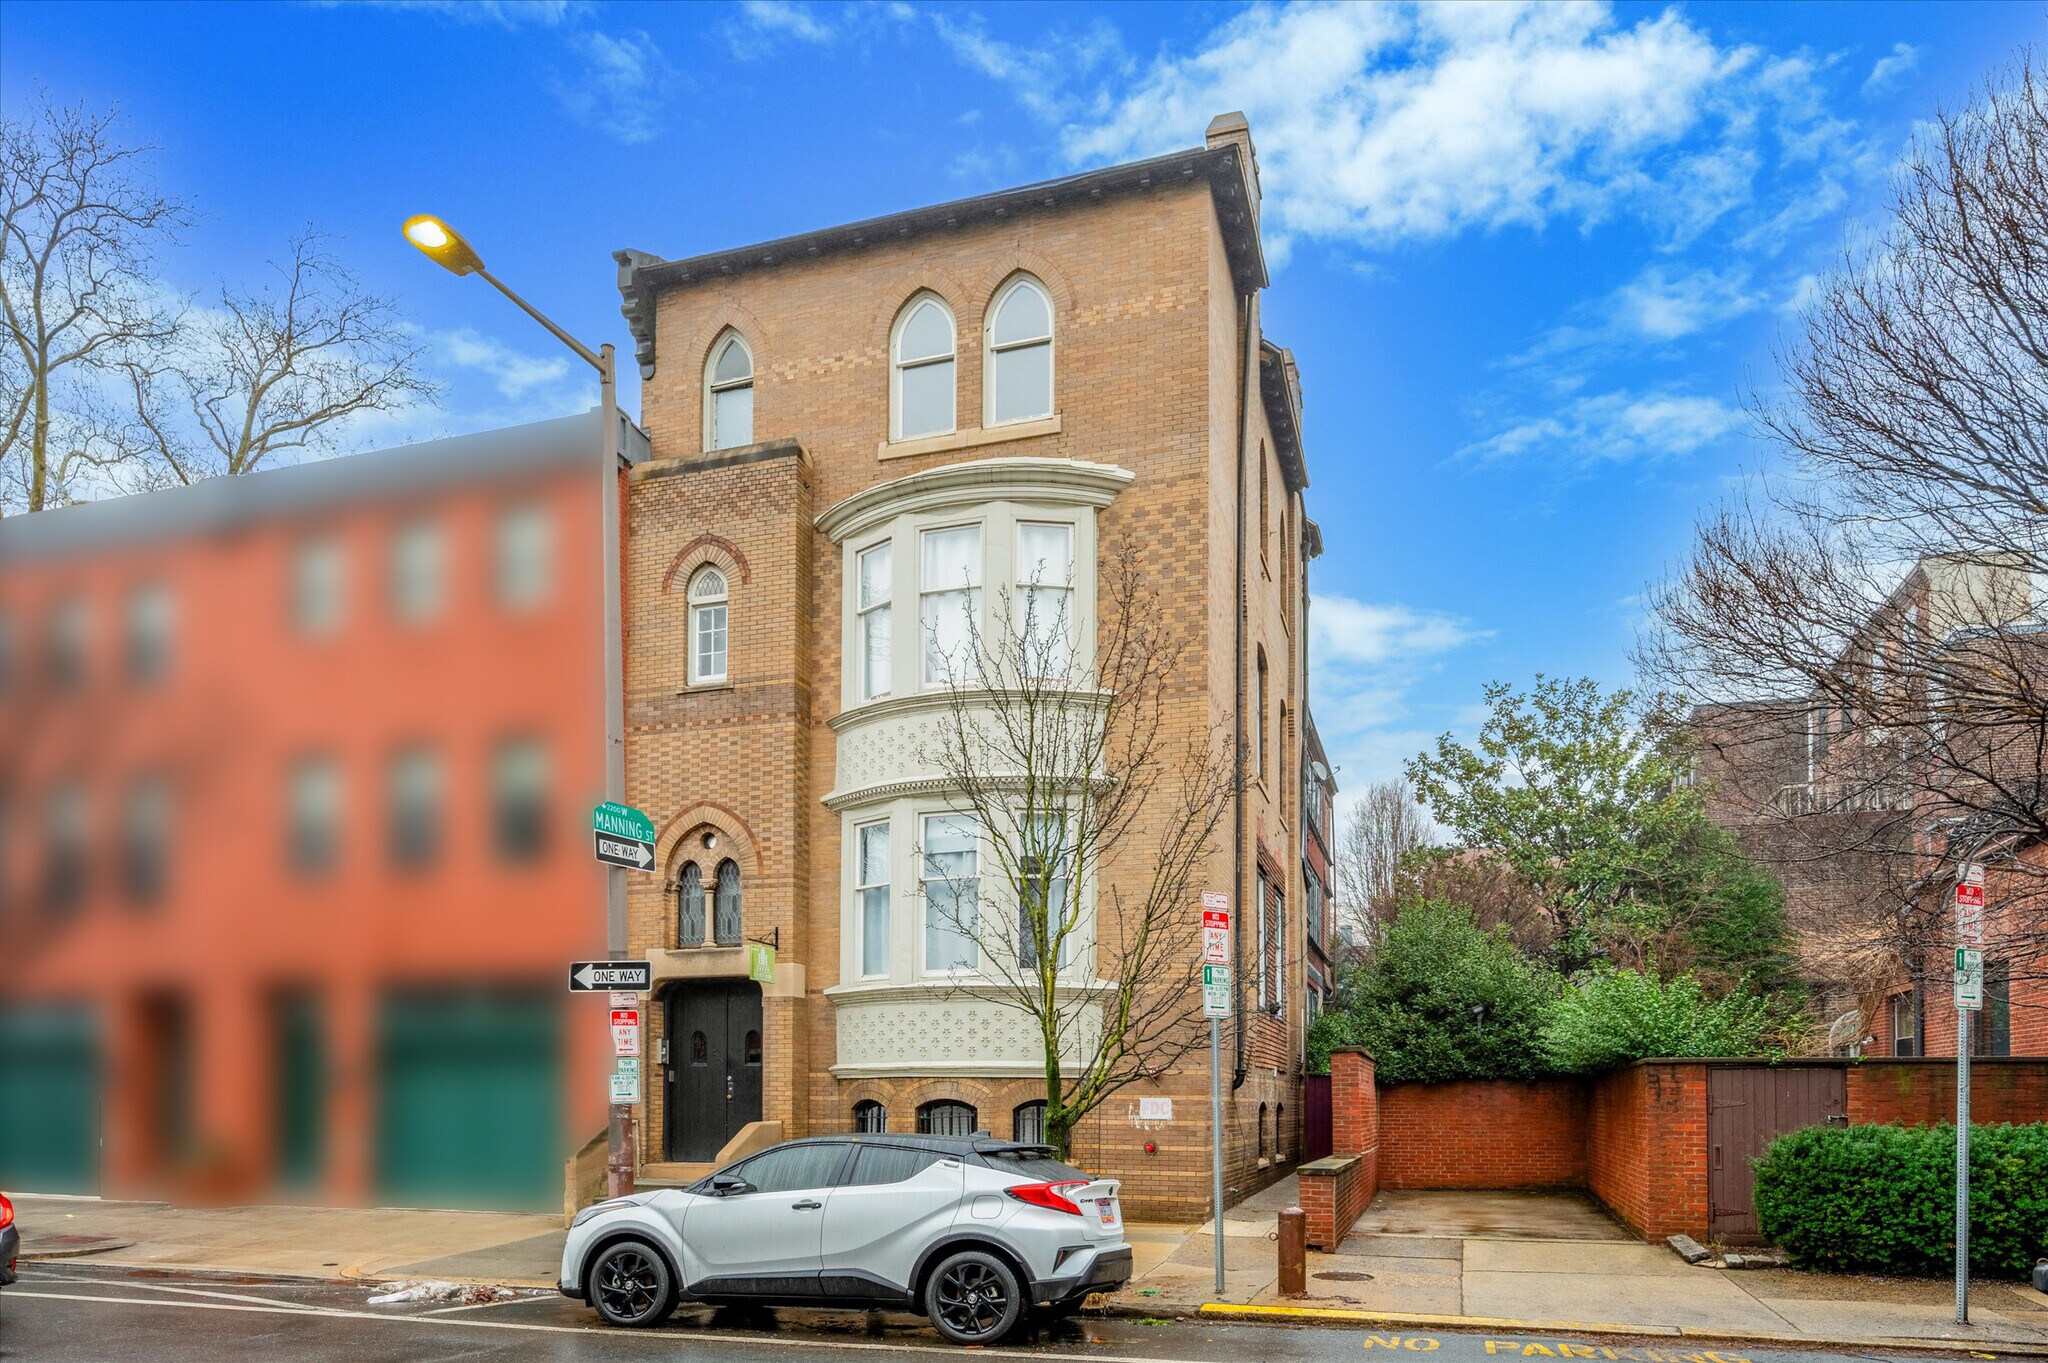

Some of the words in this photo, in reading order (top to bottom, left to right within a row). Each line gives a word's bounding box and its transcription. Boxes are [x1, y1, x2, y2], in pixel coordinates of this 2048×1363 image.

[606, 804, 620, 813] 2200
[621, 807, 628, 816] W
[595, 811, 643, 839] MANNING
[645, 830, 653, 842] ST
[602, 841, 620, 856] ONE
[621, 846, 639, 860] WAY
[1966, 887, 1974, 895] NO
[1959, 894, 1982, 905] STOPPING
[1204, 919, 1228, 928] STOPPING
[1210, 932, 1222, 940] ANY
[1209, 942, 1224, 951] TIME
[593, 971, 615, 982] ONE
[619, 970, 642, 982] WAY
[618, 1028, 632, 1036] ANY
[617, 1038, 633, 1046] TIME
[1363, 1335, 1440, 1350] NO
